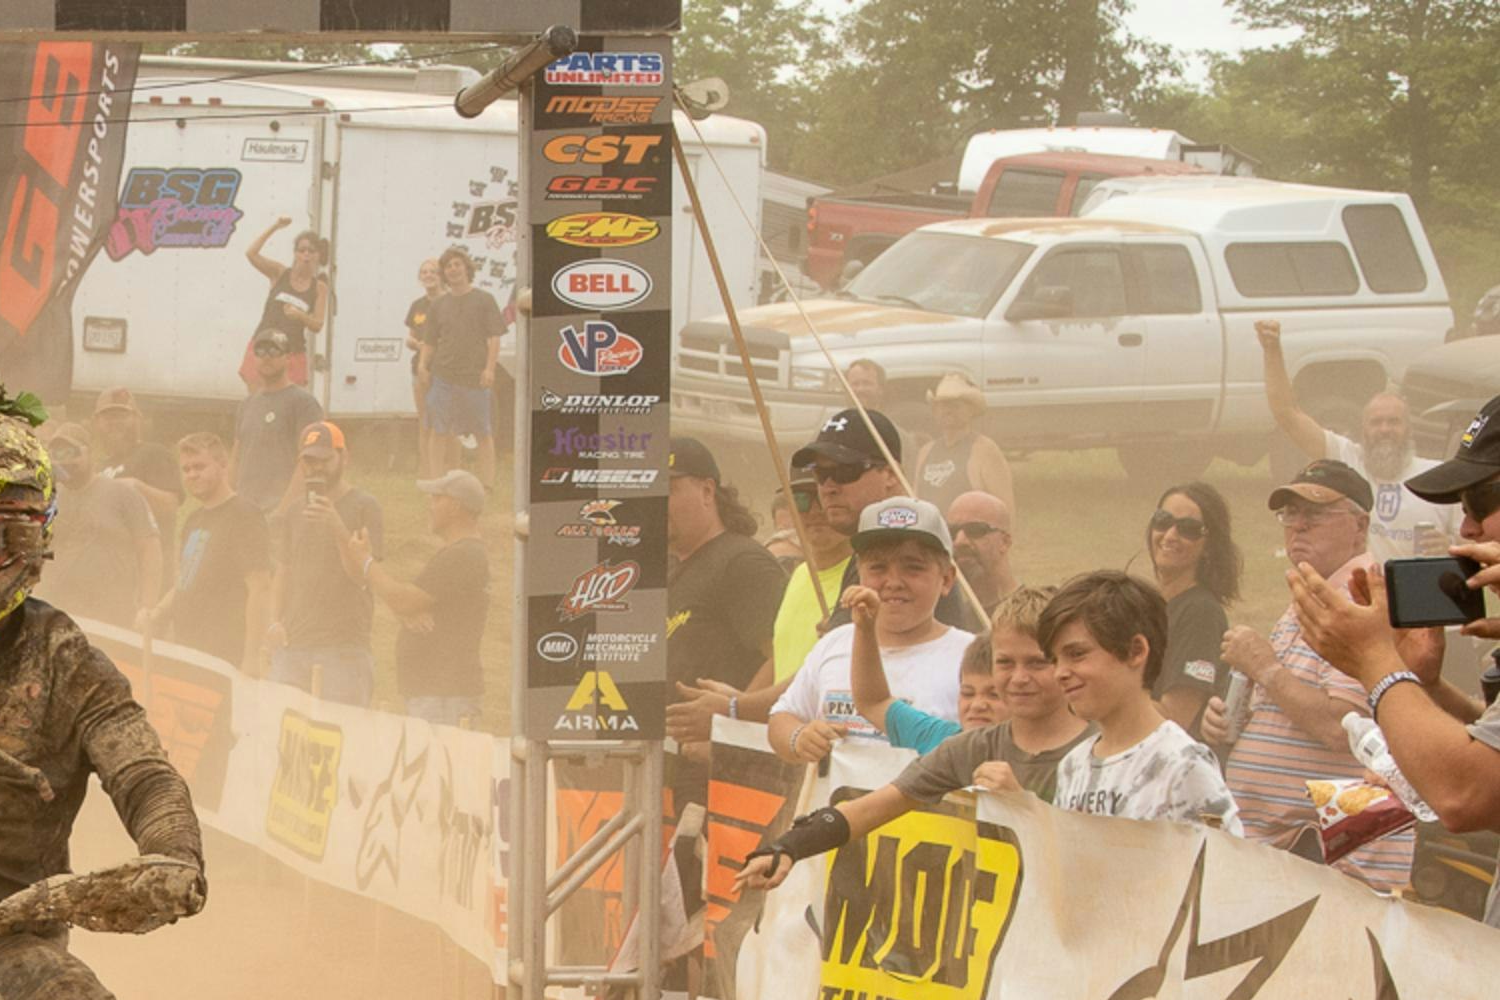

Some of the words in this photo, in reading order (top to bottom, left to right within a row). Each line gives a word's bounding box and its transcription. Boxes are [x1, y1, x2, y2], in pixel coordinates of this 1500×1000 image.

[548, 54, 661, 71] PARTS
[547, 72, 661, 83] UNLIMITED
[545, 96, 661, 113] MOOSE
[590, 113, 651, 123] RACING
[544, 135, 661, 165] CST
[124, 171, 240, 207] BSG
[548, 177, 658, 192] GBC
[547, 216, 658, 237] FMF
[569, 274, 635, 293] BELL
[562, 322, 617, 373] VP
[563, 395, 660, 407] DUNLOP
[550, 424, 652, 456] Hoosier
[587, 634, 658, 643] MOTORCYCLE
[585, 644, 649, 652] MECHANICS
[583, 654, 640, 662] INSTITUTE
[554, 715, 640, 731] ARMA
